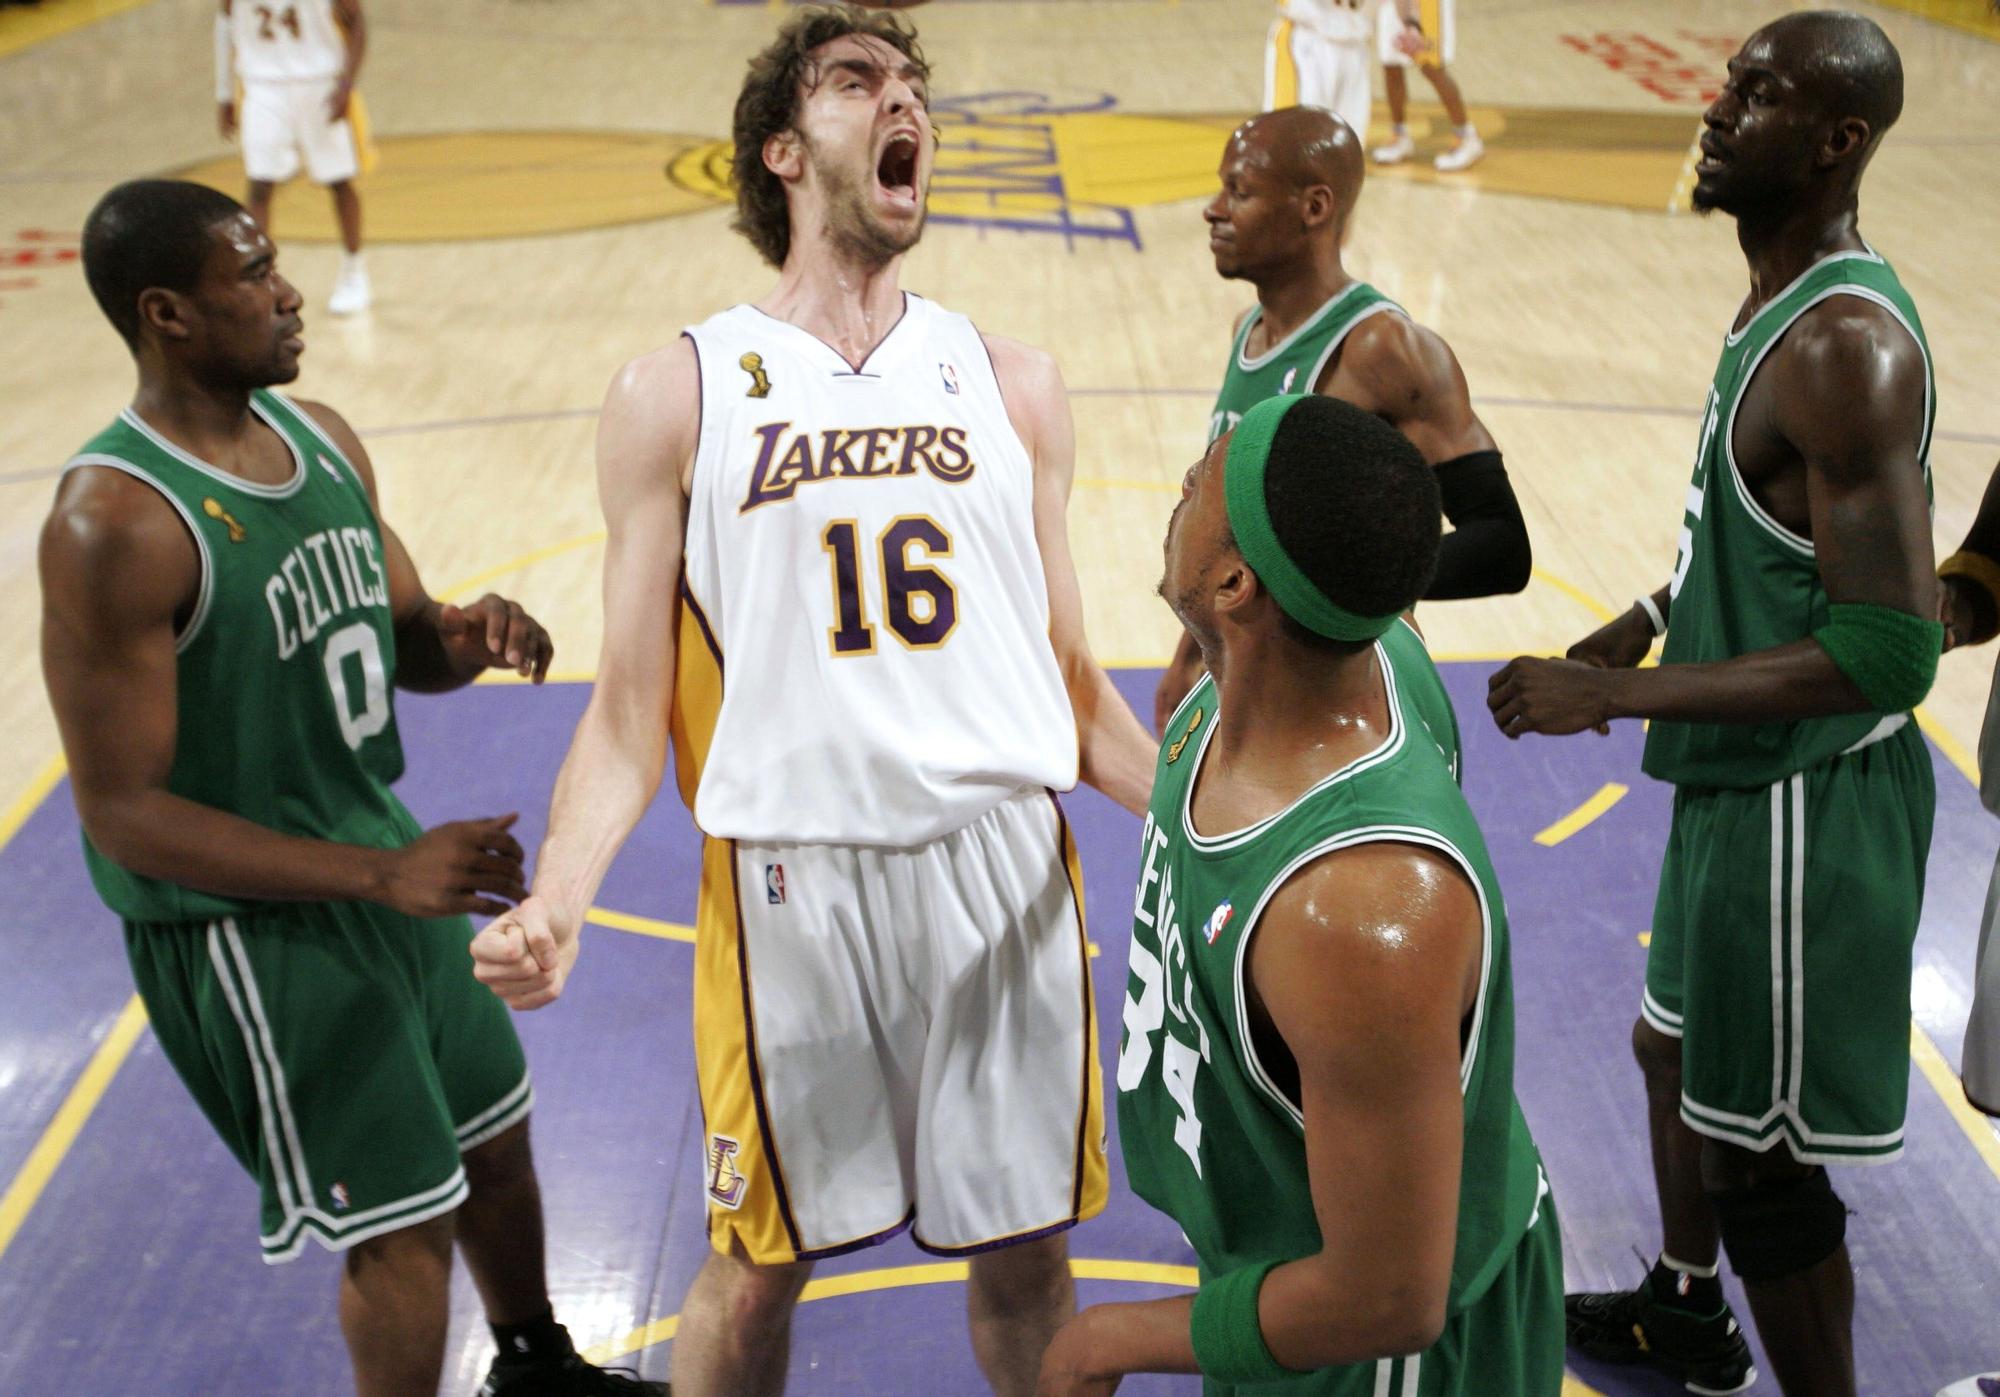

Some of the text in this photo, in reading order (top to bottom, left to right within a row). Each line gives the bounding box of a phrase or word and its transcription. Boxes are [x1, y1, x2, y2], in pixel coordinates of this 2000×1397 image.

[253, 4, 300, 41] 24
[738, 420, 975, 516] LAKERS
[265, 526, 390, 661] CELTICS
[820, 513, 960, 659] 16
[323, 621, 390, 752] 0
